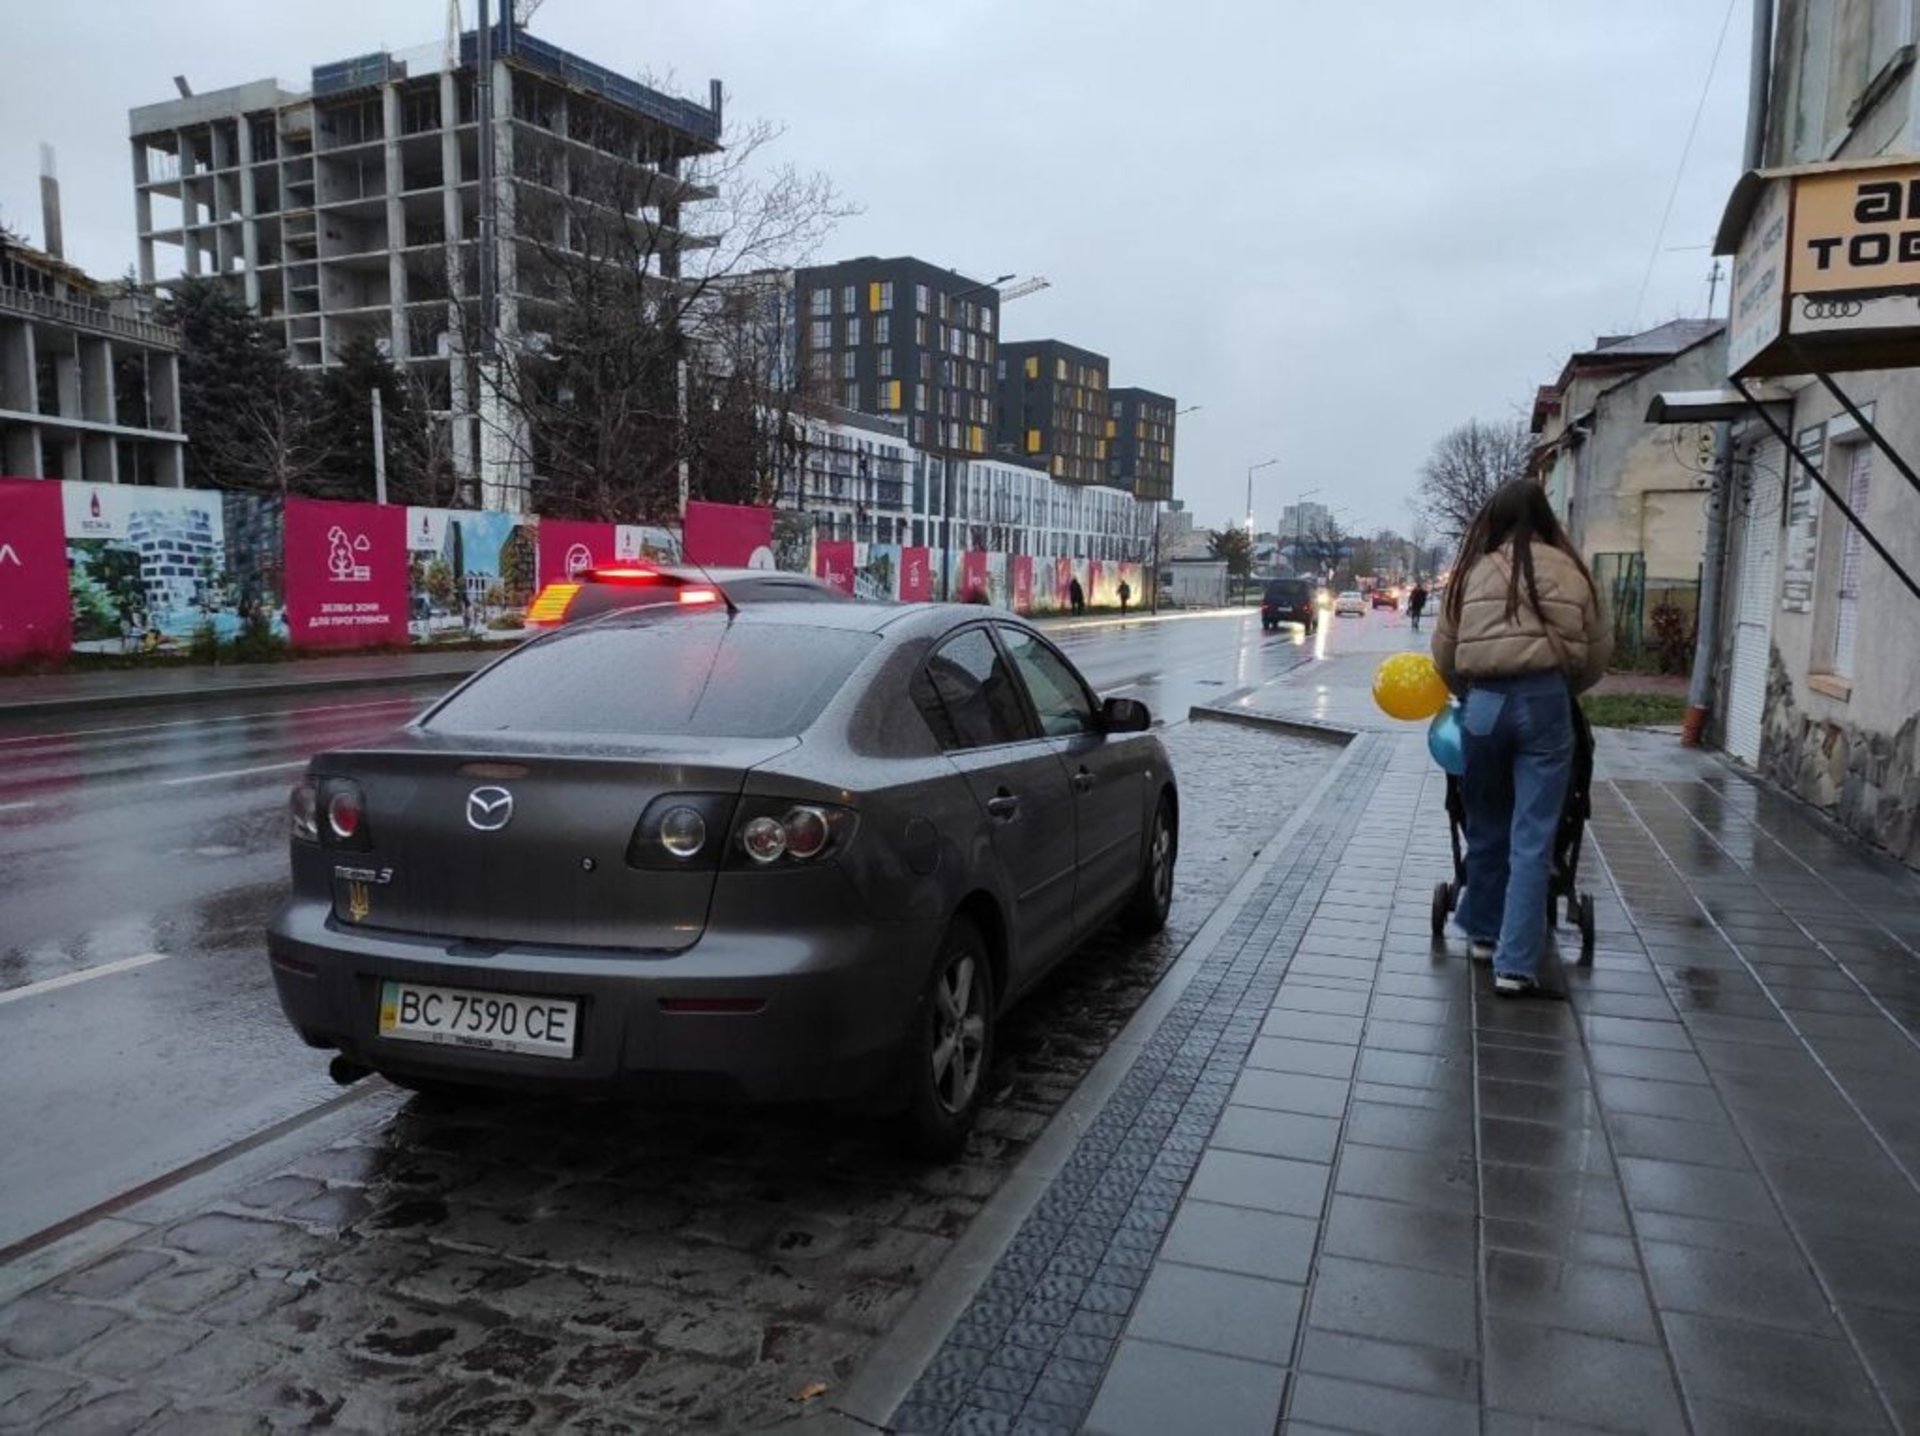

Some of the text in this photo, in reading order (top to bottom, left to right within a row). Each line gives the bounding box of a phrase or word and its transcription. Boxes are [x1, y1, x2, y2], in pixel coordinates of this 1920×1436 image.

[376, 868, 393, 884] 3
[400, 991, 568, 1042] BC 7590 CE
